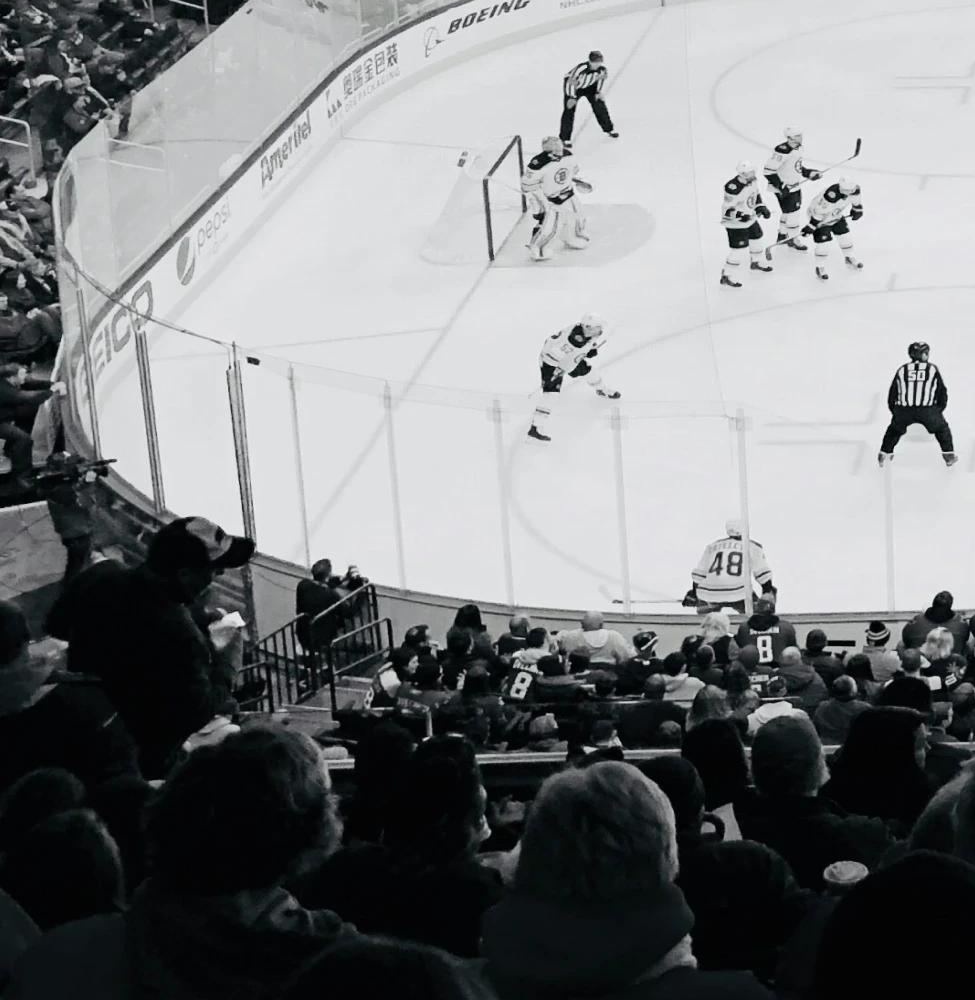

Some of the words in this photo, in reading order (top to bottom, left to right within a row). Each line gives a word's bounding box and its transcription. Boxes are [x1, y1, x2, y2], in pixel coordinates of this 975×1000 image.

[197, 197, 232, 255] pepsi
[907, 369, 926, 381] 50
[708, 550, 743, 577] 48
[757, 635, 774, 663] 8
[510, 671, 534, 700] 8
